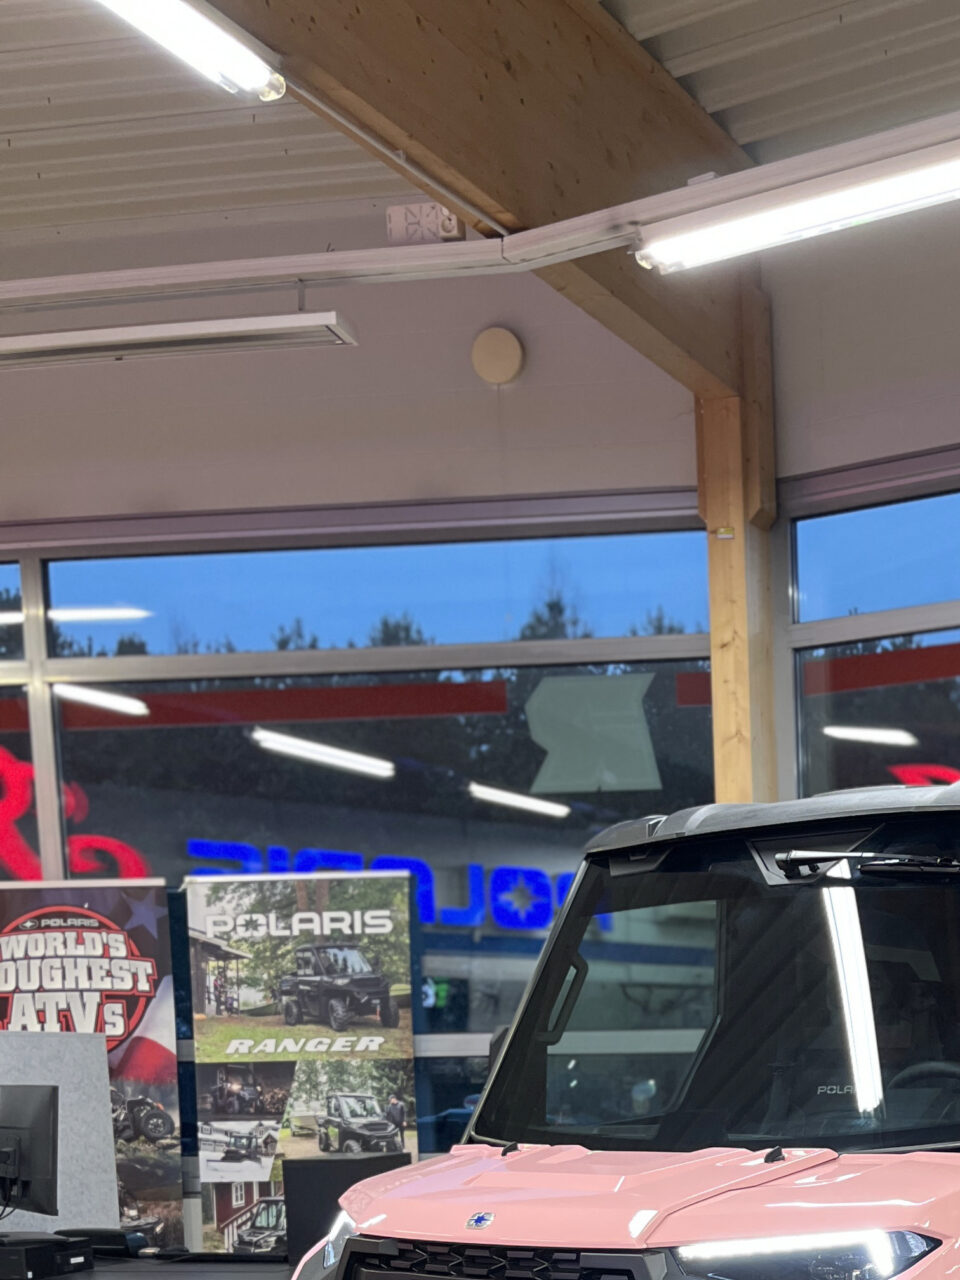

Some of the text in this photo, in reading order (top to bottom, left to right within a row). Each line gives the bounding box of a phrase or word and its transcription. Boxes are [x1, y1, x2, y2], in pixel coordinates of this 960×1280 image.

[41, 918, 99, 928] POLARIS
[206, 909, 393, 938] POLARIS
[1, 931, 127, 959] WORLD'S
[0, 958, 152, 991] OUGHEST
[226, 1036, 384, 1054] RANGER
[817, 1085, 857, 1095] POLA
